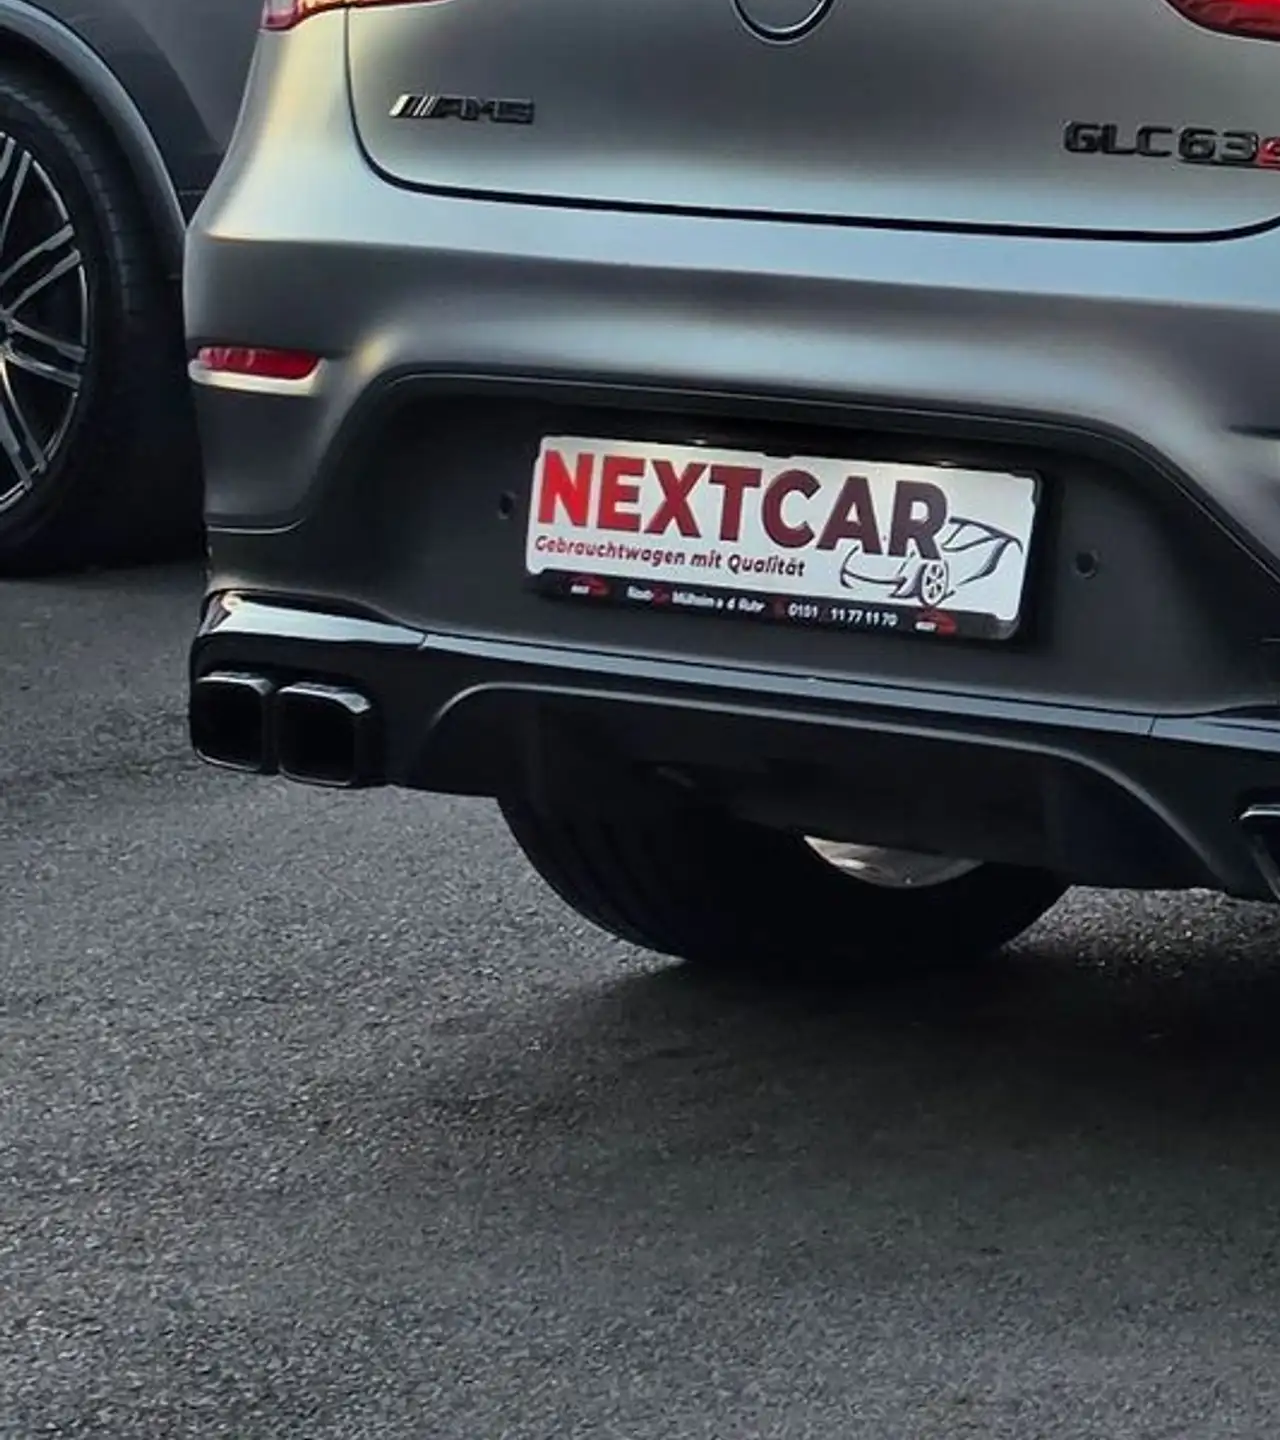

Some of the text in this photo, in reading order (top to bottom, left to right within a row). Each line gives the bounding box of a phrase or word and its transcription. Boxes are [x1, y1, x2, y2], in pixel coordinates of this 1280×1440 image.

[537, 449, 948, 560] NEXTCAR
[534, 535, 806, 578] Gebrauchtwagen mit Qualität
